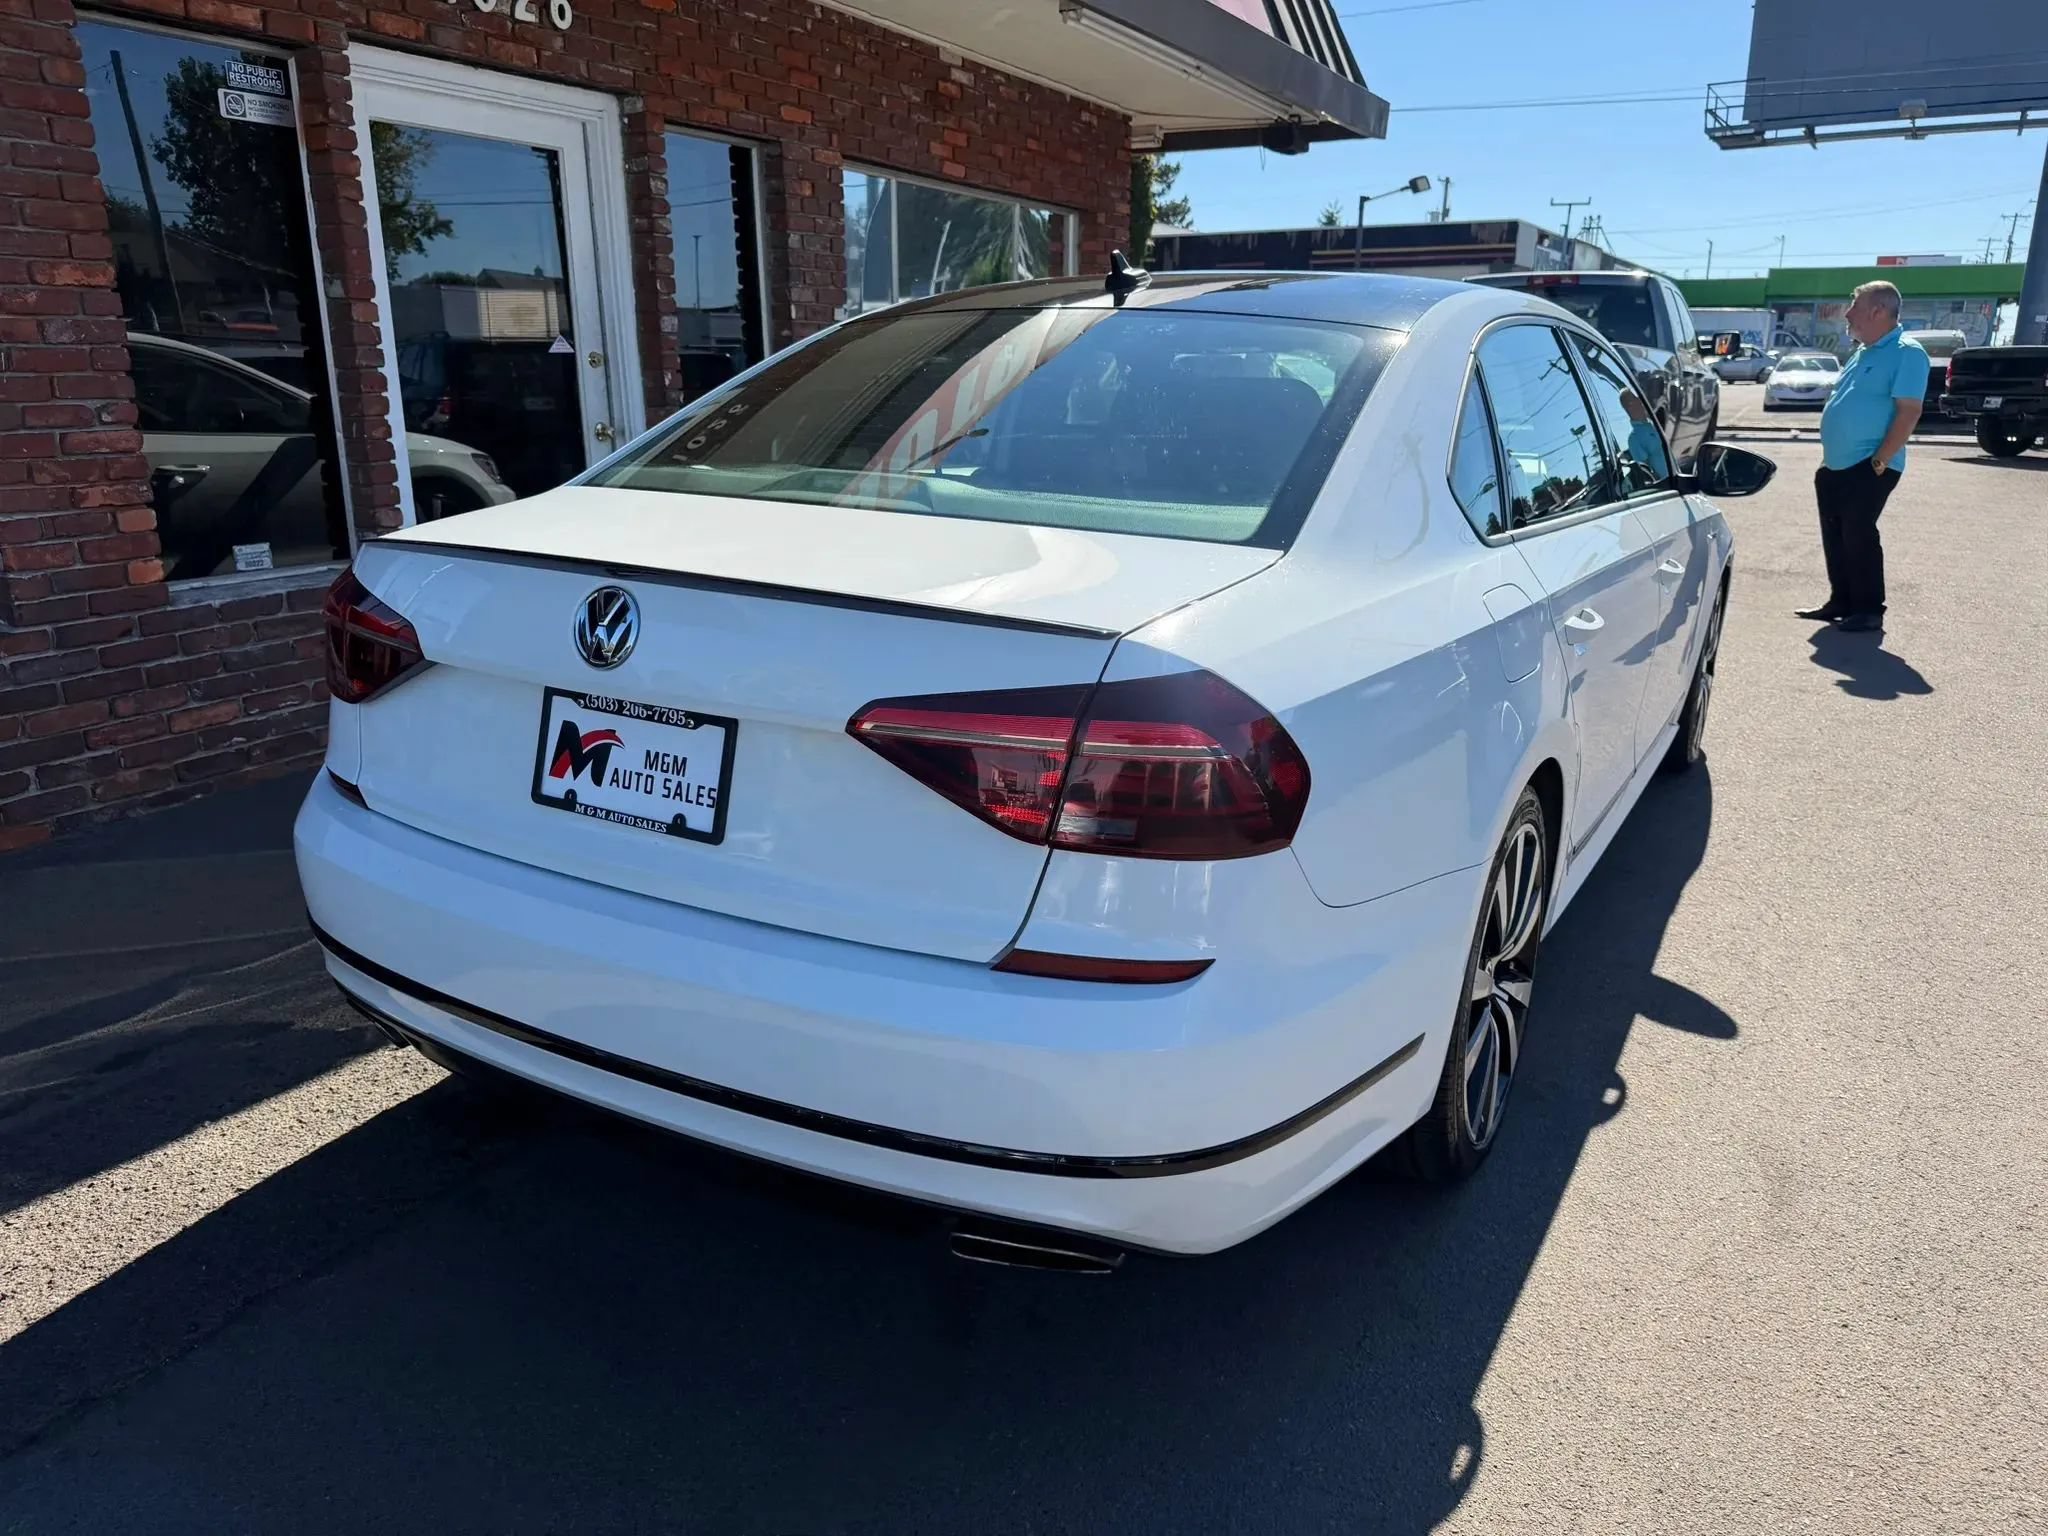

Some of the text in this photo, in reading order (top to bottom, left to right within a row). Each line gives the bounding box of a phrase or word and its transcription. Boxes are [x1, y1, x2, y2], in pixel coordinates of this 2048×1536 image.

[229, 72, 282, 89] RESTROOMS
[231, 63, 278, 79] NO PUBLIC
[585, 693, 686, 726] (503) 206-7795
[644, 750, 688, 778] M&M
[609, 768, 717, 809] AUTO SALES
[575, 804, 667, 834] M & M AUTO SALES
